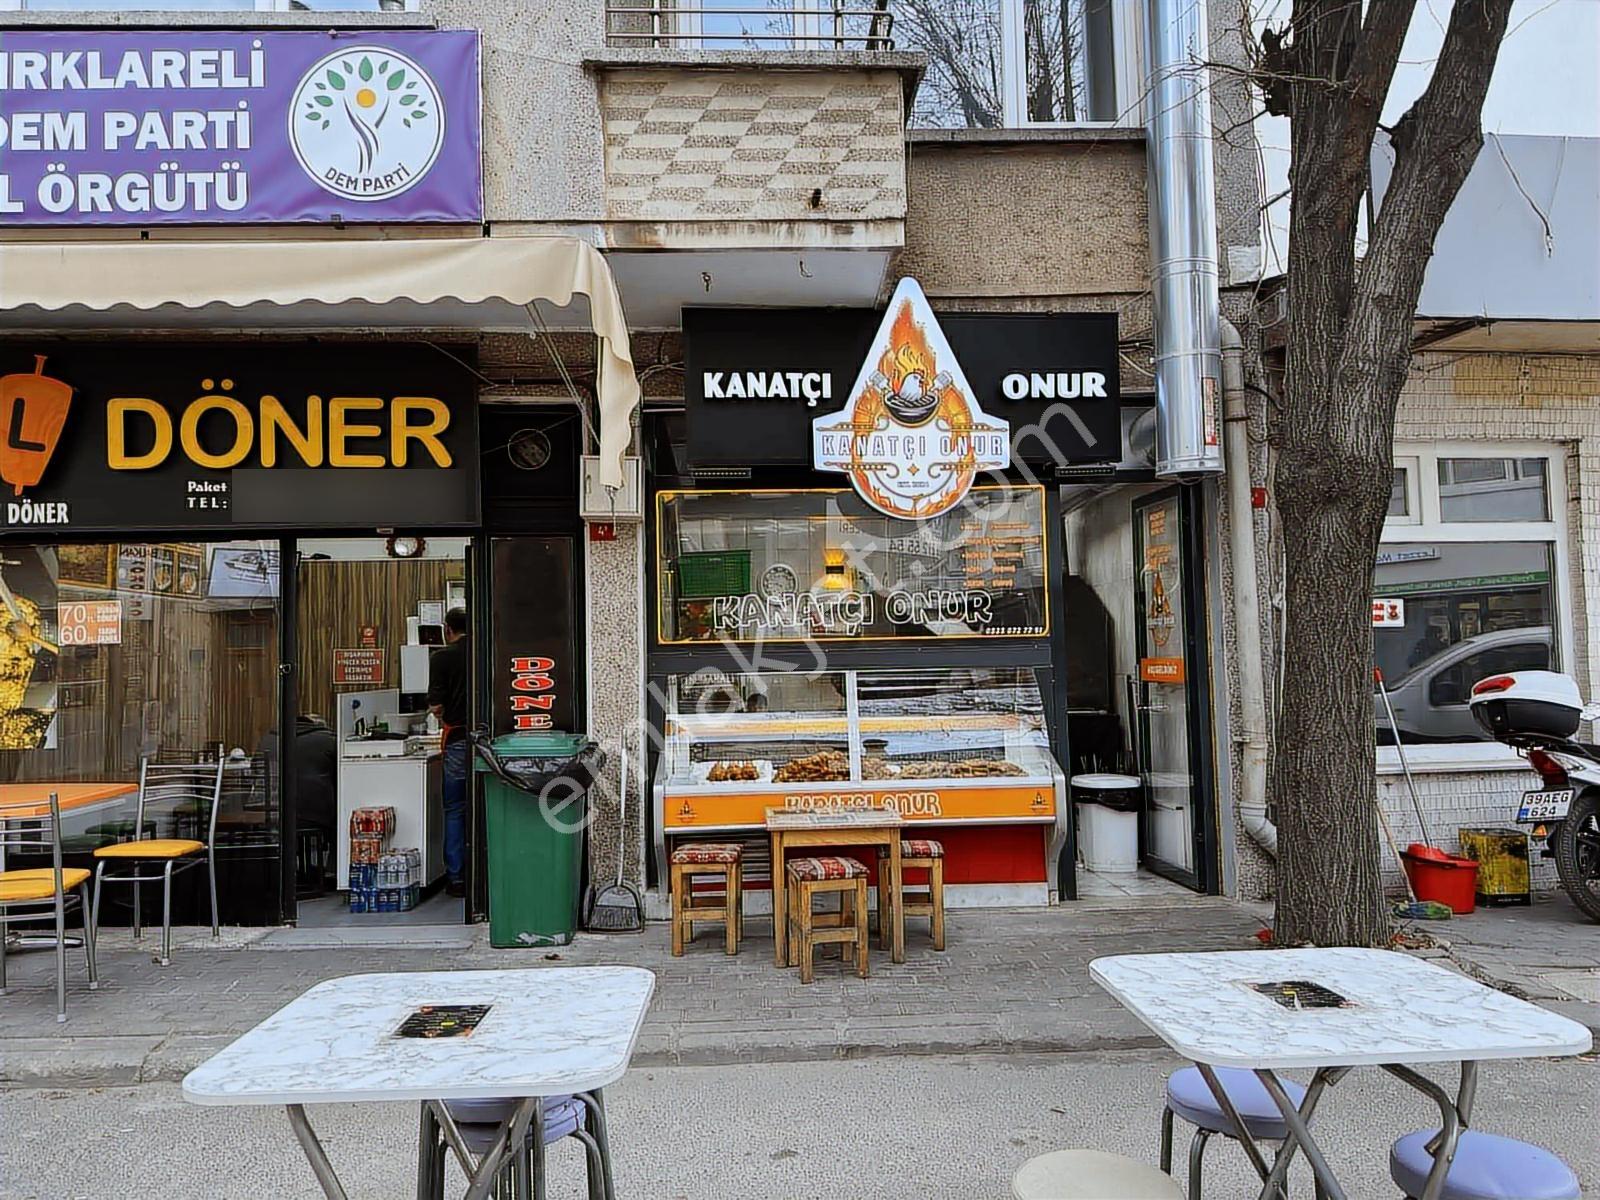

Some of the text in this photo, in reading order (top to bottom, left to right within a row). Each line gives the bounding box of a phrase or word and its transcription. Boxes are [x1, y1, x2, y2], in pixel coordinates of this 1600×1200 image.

[0, 100, 251, 151] EM PARTİ
[37, 162, 249, 214] ÖRGÜTÜ
[324, 162, 411, 192] DEM PARTİ
[703, 371, 1108, 407] KANATÇI ONUR
[106, 378, 453, 470] DÖNER
[821, 434, 1004, 461] KANATÇI ONUR
[187, 480, 228, 493] Paket
[7, 498, 70, 524] DÖNER
[60, 604, 87, 624] 70
[714, 589, 993, 636] KANATÇI ONUR
[60, 625, 87, 644] 60
